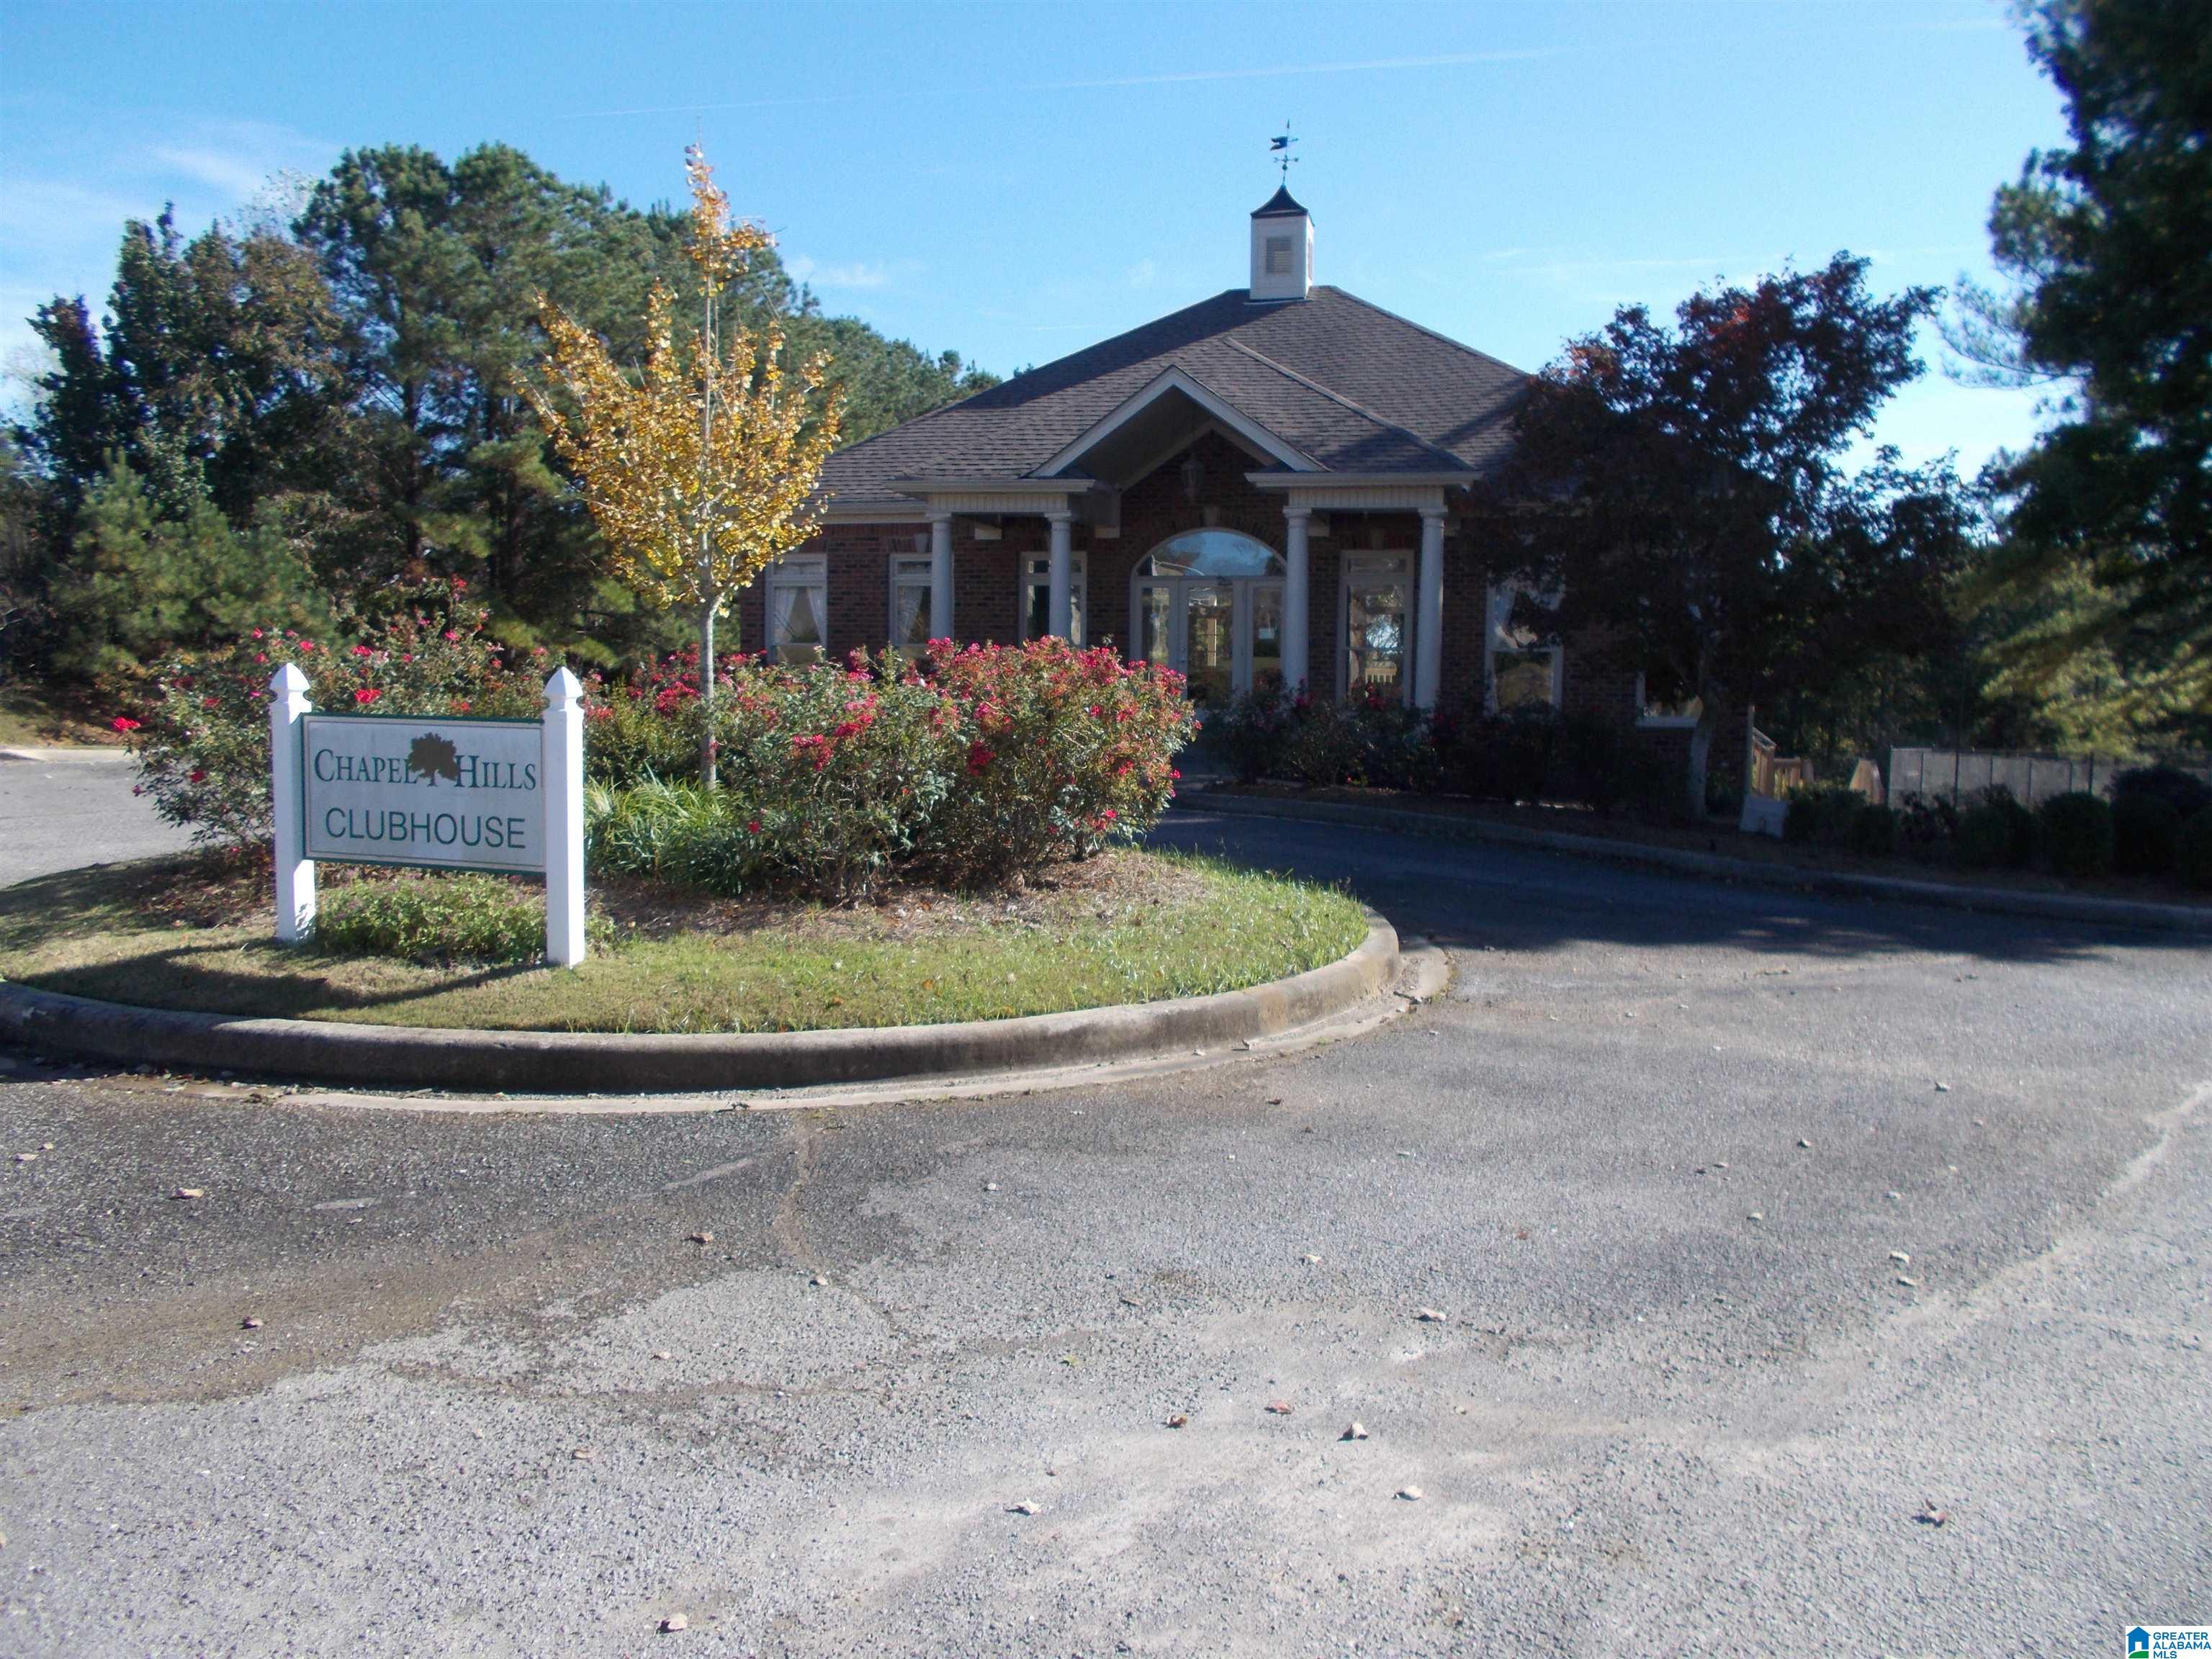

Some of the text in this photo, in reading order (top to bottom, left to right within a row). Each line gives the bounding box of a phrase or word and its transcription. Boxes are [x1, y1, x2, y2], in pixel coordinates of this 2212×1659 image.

[314, 748, 537, 791] CHAPEL HILLS
[325, 807, 526, 849] CLUBHOUSE
